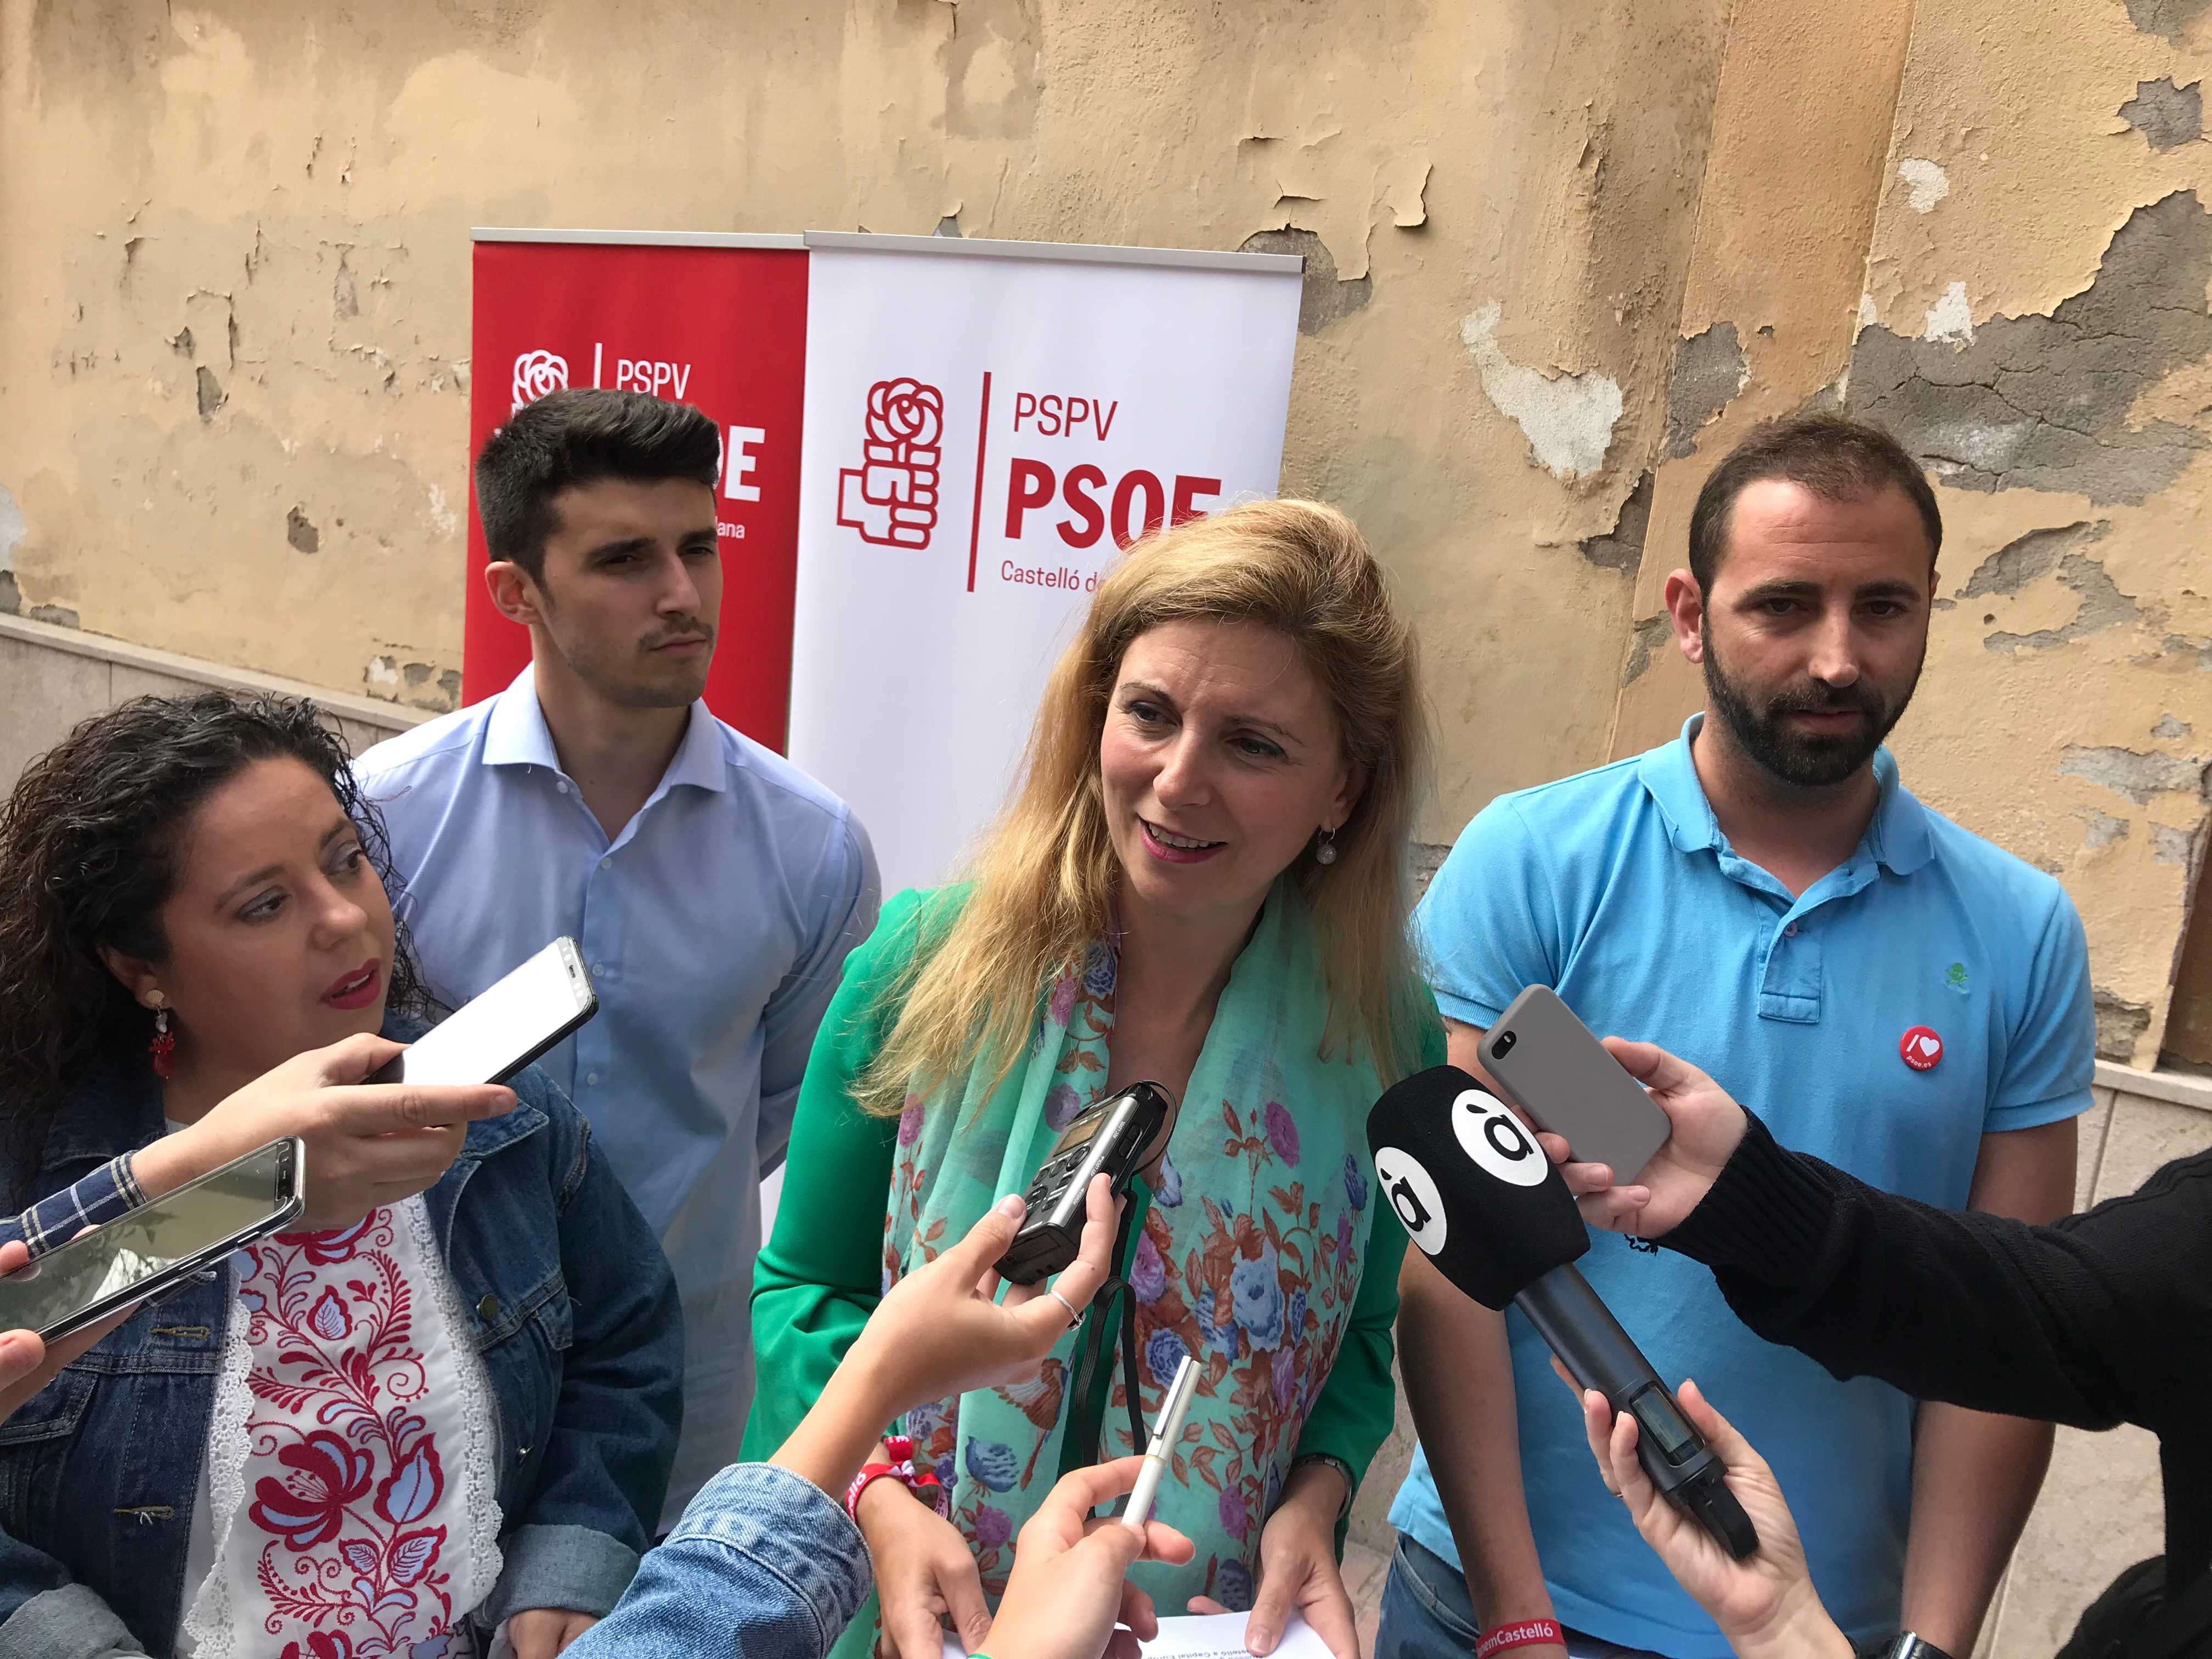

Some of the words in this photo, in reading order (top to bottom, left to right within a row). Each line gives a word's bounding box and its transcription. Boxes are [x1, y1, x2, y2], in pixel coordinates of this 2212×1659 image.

[616, 359, 691, 400] PSPV
[1014, 392, 1119, 442] PSPV
[1001, 560, 1080, 590] Castelló
